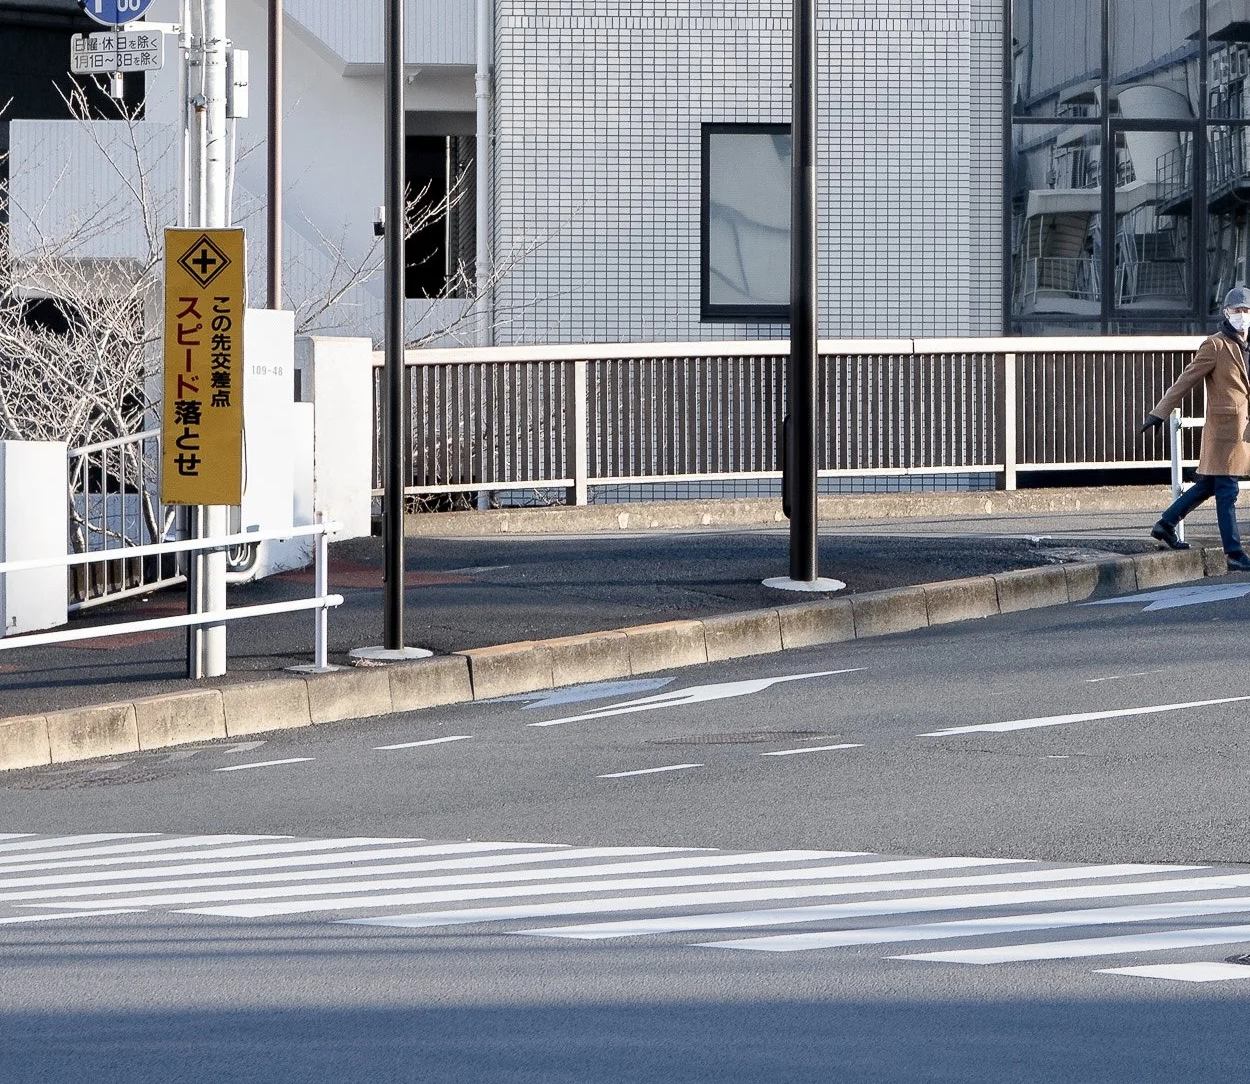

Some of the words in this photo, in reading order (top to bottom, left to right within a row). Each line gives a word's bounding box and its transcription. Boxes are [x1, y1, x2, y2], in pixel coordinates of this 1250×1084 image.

[174, 296, 203, 477] スピード落とせ
[210, 296, 232, 408] この先交差点
[252, 365, 283, 376] 109-48
